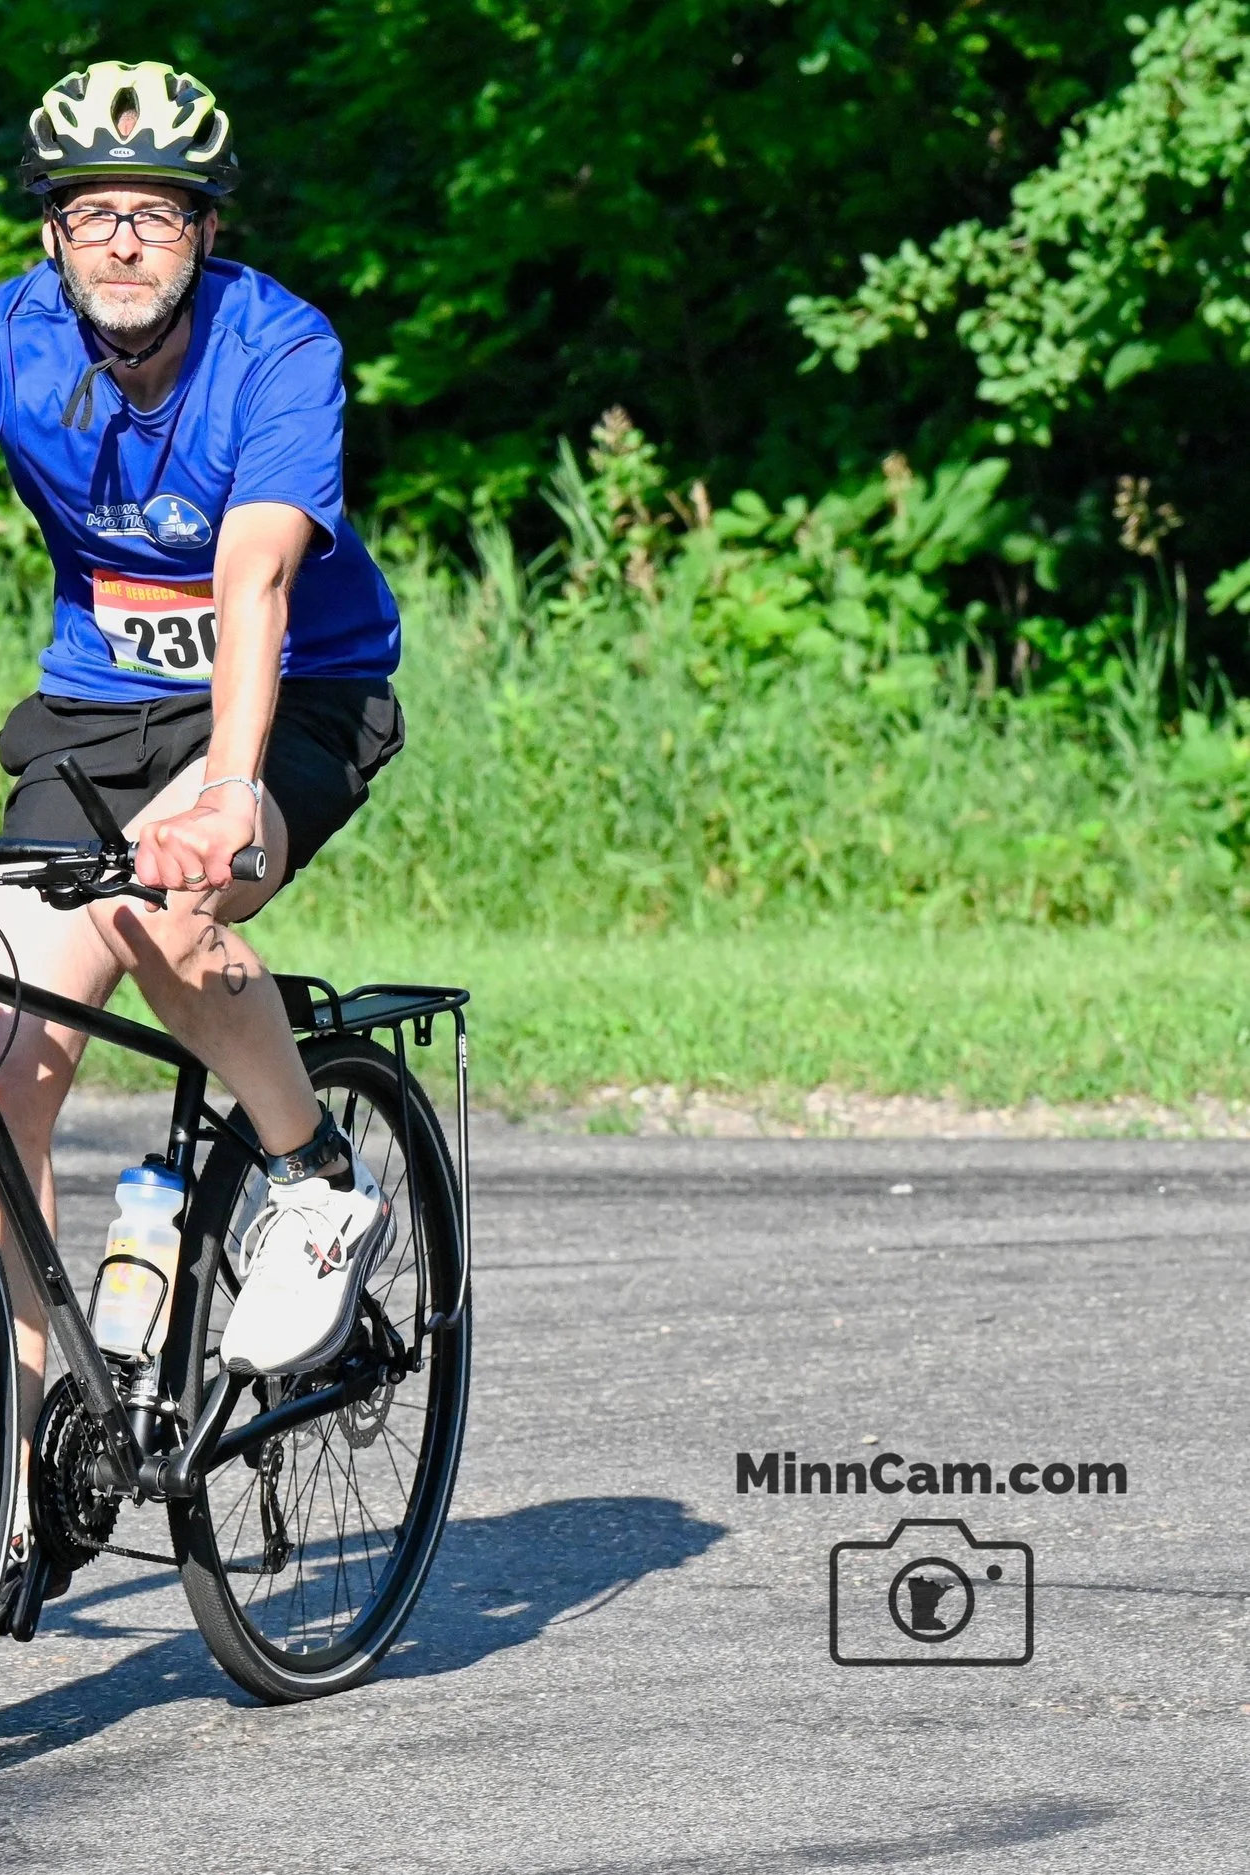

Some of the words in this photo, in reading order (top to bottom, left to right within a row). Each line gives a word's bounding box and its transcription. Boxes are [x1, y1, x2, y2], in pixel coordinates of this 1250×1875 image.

[158, 523, 202, 542] 5K
[99, 581, 122, 597] LAKE
[125, 586, 178, 600] REBECCA
[285, 1154, 305, 1179] 230
